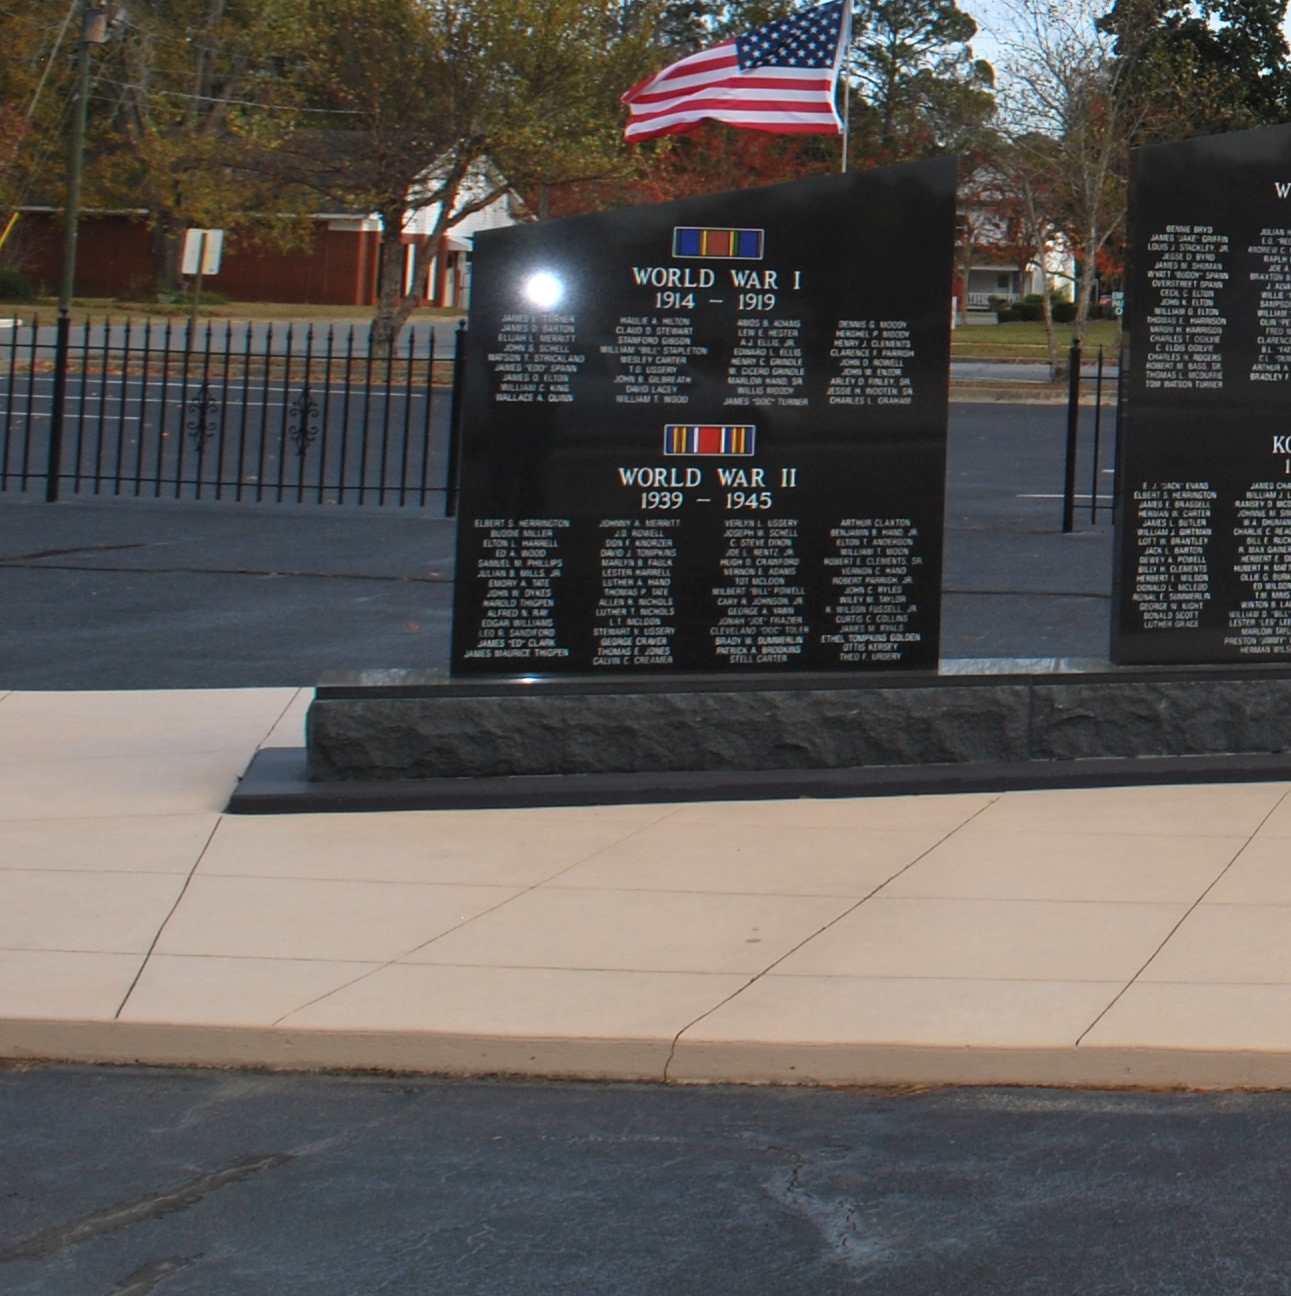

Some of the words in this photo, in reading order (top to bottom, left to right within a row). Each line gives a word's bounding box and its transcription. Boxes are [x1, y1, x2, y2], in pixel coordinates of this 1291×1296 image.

[632, 267, 715, 288] WORLD
[730, 269, 778, 289] WAR
[793, 270, 800, 289] I
[655, 291, 695, 308] 1914
[738, 292, 775, 310] 1919
[618, 467, 701, 487] WORLD
[716, 467, 765, 487] WAR
[781, 468, 797, 487] II
[641, 491, 683, 509] 1939
[726, 491, 772, 509] 1945
